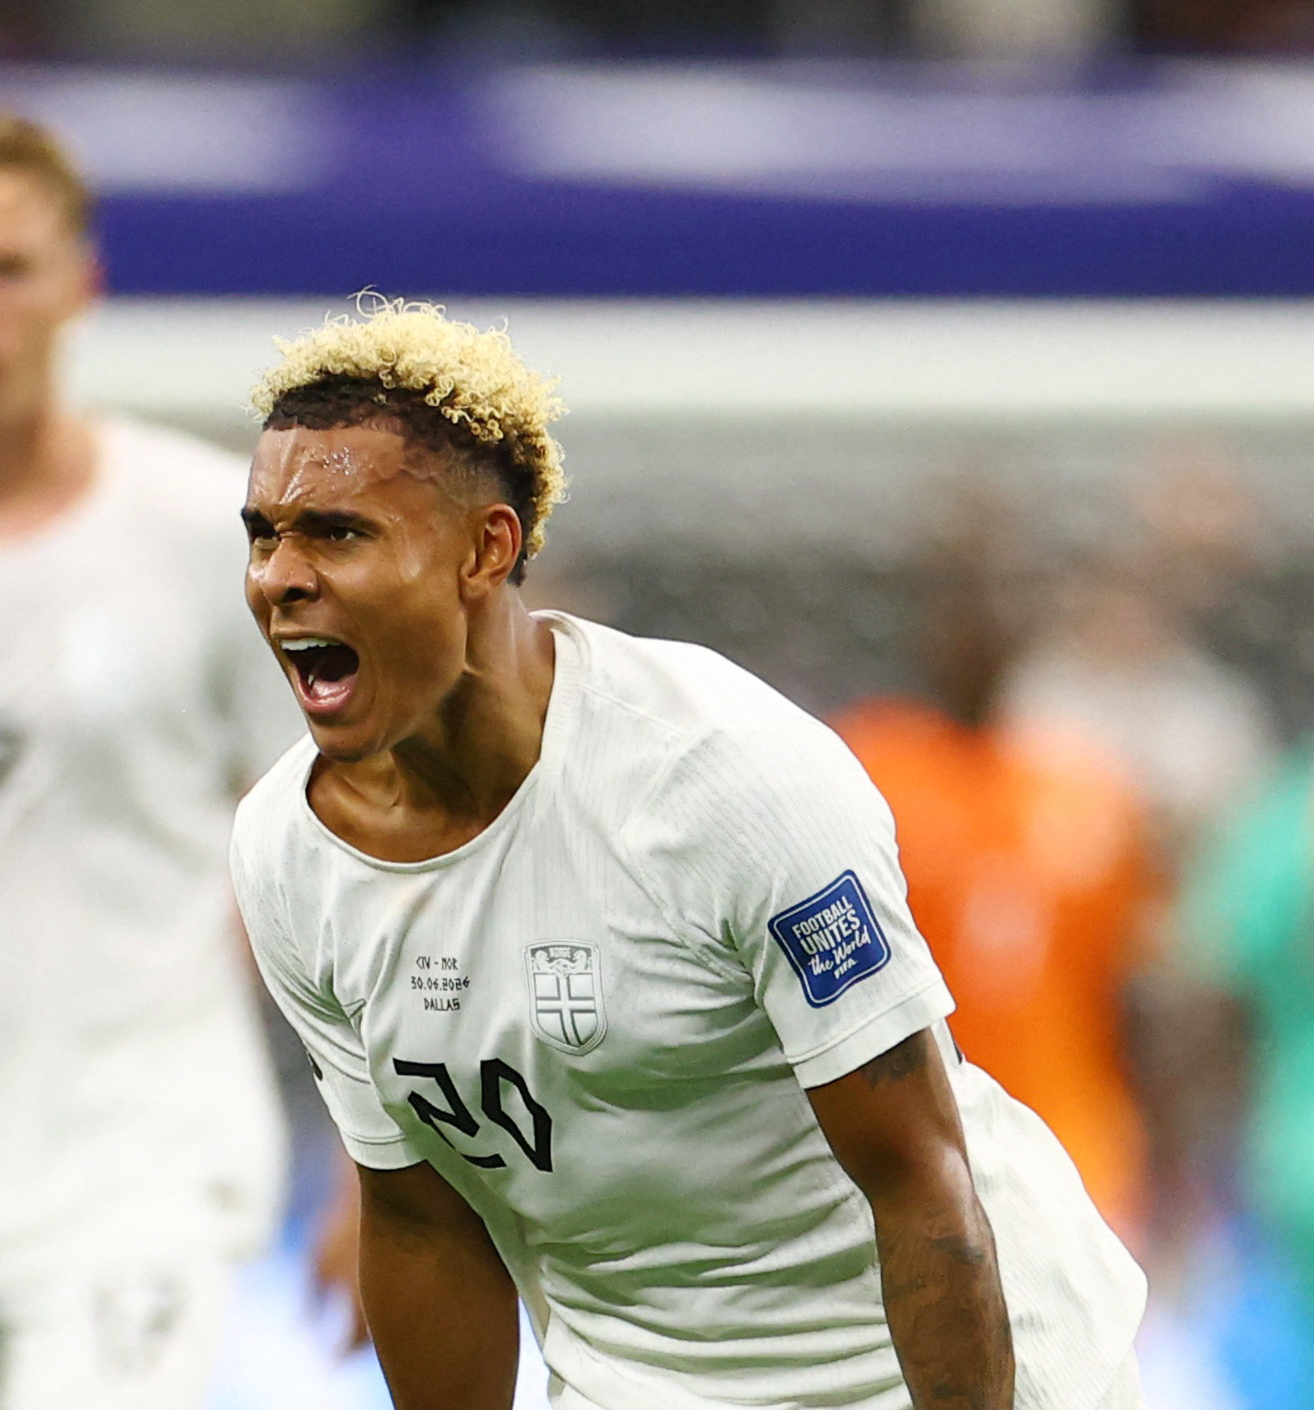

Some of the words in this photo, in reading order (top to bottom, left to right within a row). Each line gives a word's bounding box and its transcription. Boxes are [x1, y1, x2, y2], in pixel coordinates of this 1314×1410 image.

[792, 895, 853, 939] FOOTBALL
[800, 909, 861, 955] UNITES
[416, 956, 430, 970] CIV
[808, 954, 834, 976] the
[832, 924, 871, 965] World
[411, 975, 470, 991] 30.06.2026
[834, 958, 857, 979] FIFA
[423, 997, 460, 1011] DALLAS
[392, 1057, 553, 1173] 20
